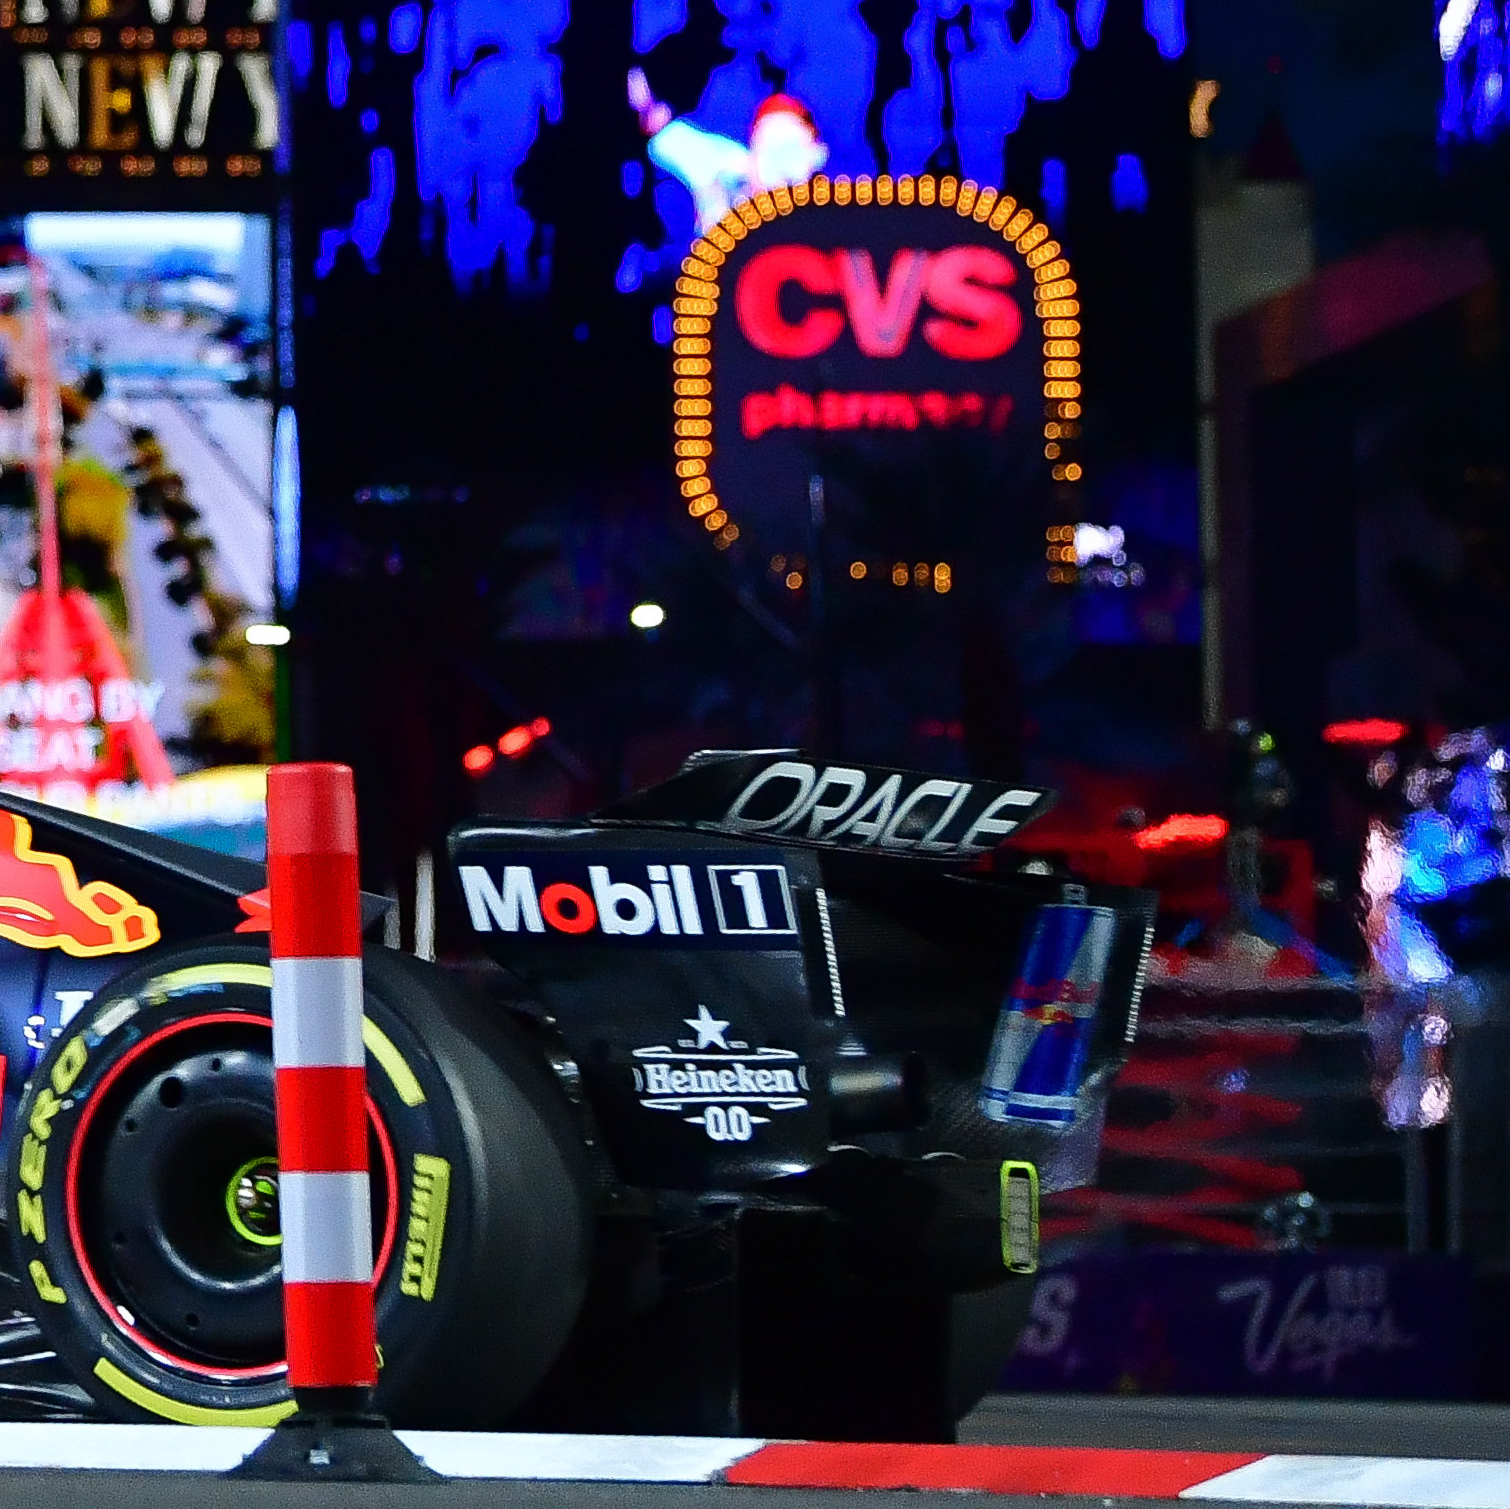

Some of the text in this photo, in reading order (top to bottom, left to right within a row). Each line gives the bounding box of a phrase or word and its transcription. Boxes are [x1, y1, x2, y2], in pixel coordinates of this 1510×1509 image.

[21, 50, 221, 151] NEW
[735, 243, 1023, 362] CVS
[724, 760, 1042, 853] ORACLE
[458, 864, 770, 936] Mobil 1
[642, 1062, 799, 1095] Heineken
